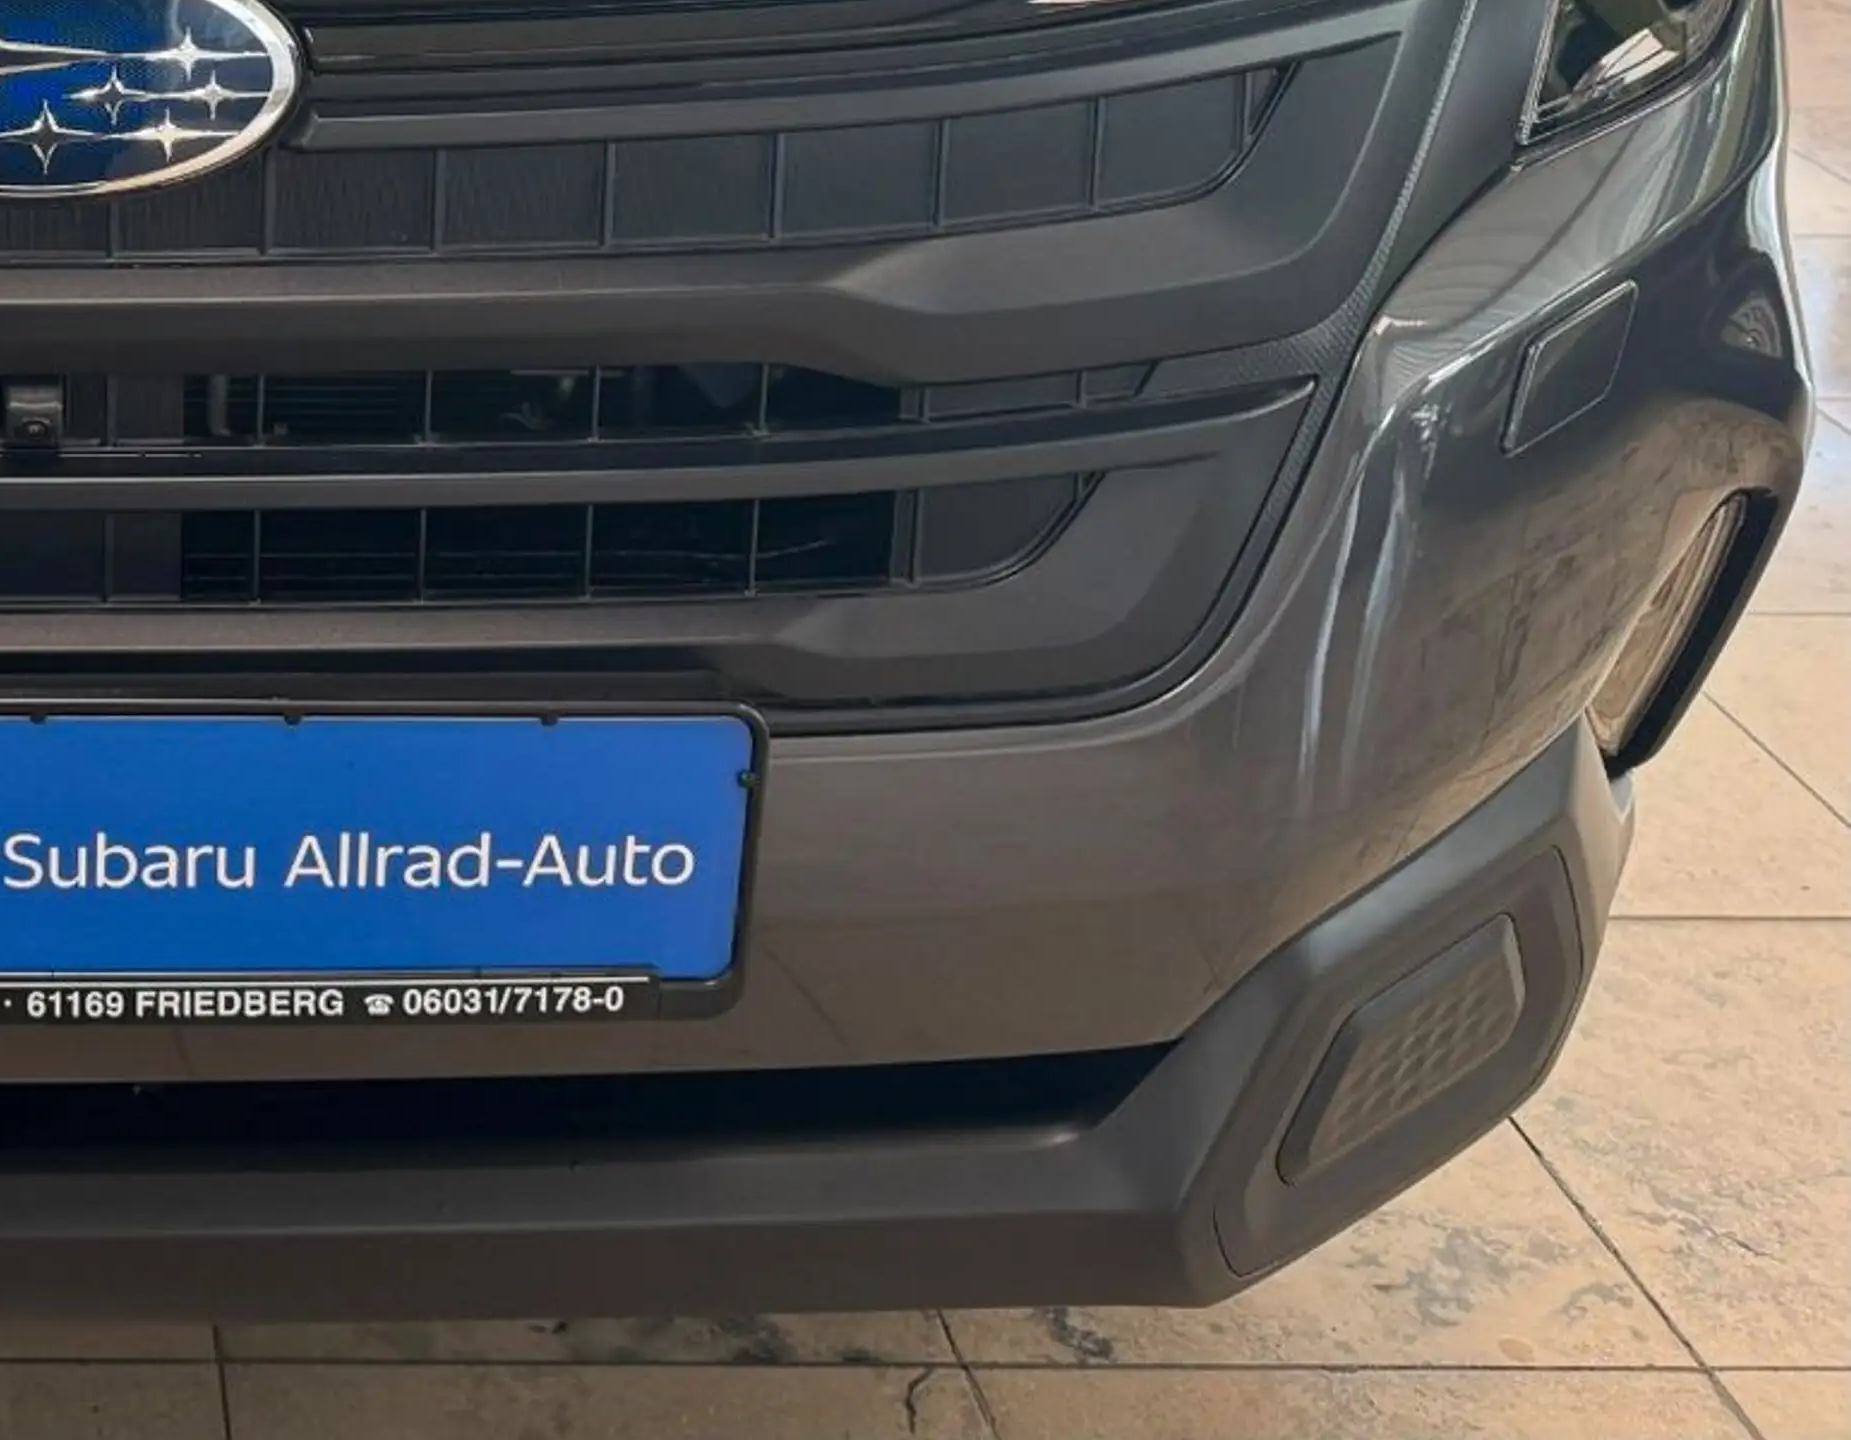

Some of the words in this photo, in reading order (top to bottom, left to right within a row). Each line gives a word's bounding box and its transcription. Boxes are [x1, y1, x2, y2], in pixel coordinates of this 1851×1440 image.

[4, 832, 255, 889] Subaru
[284, 832, 694, 888] Allrad-Auto
[27, 990, 124, 1018] 61169
[136, 988, 344, 1017] FRIEDBERG
[402, 985, 624, 1015] 06031/7178-0
